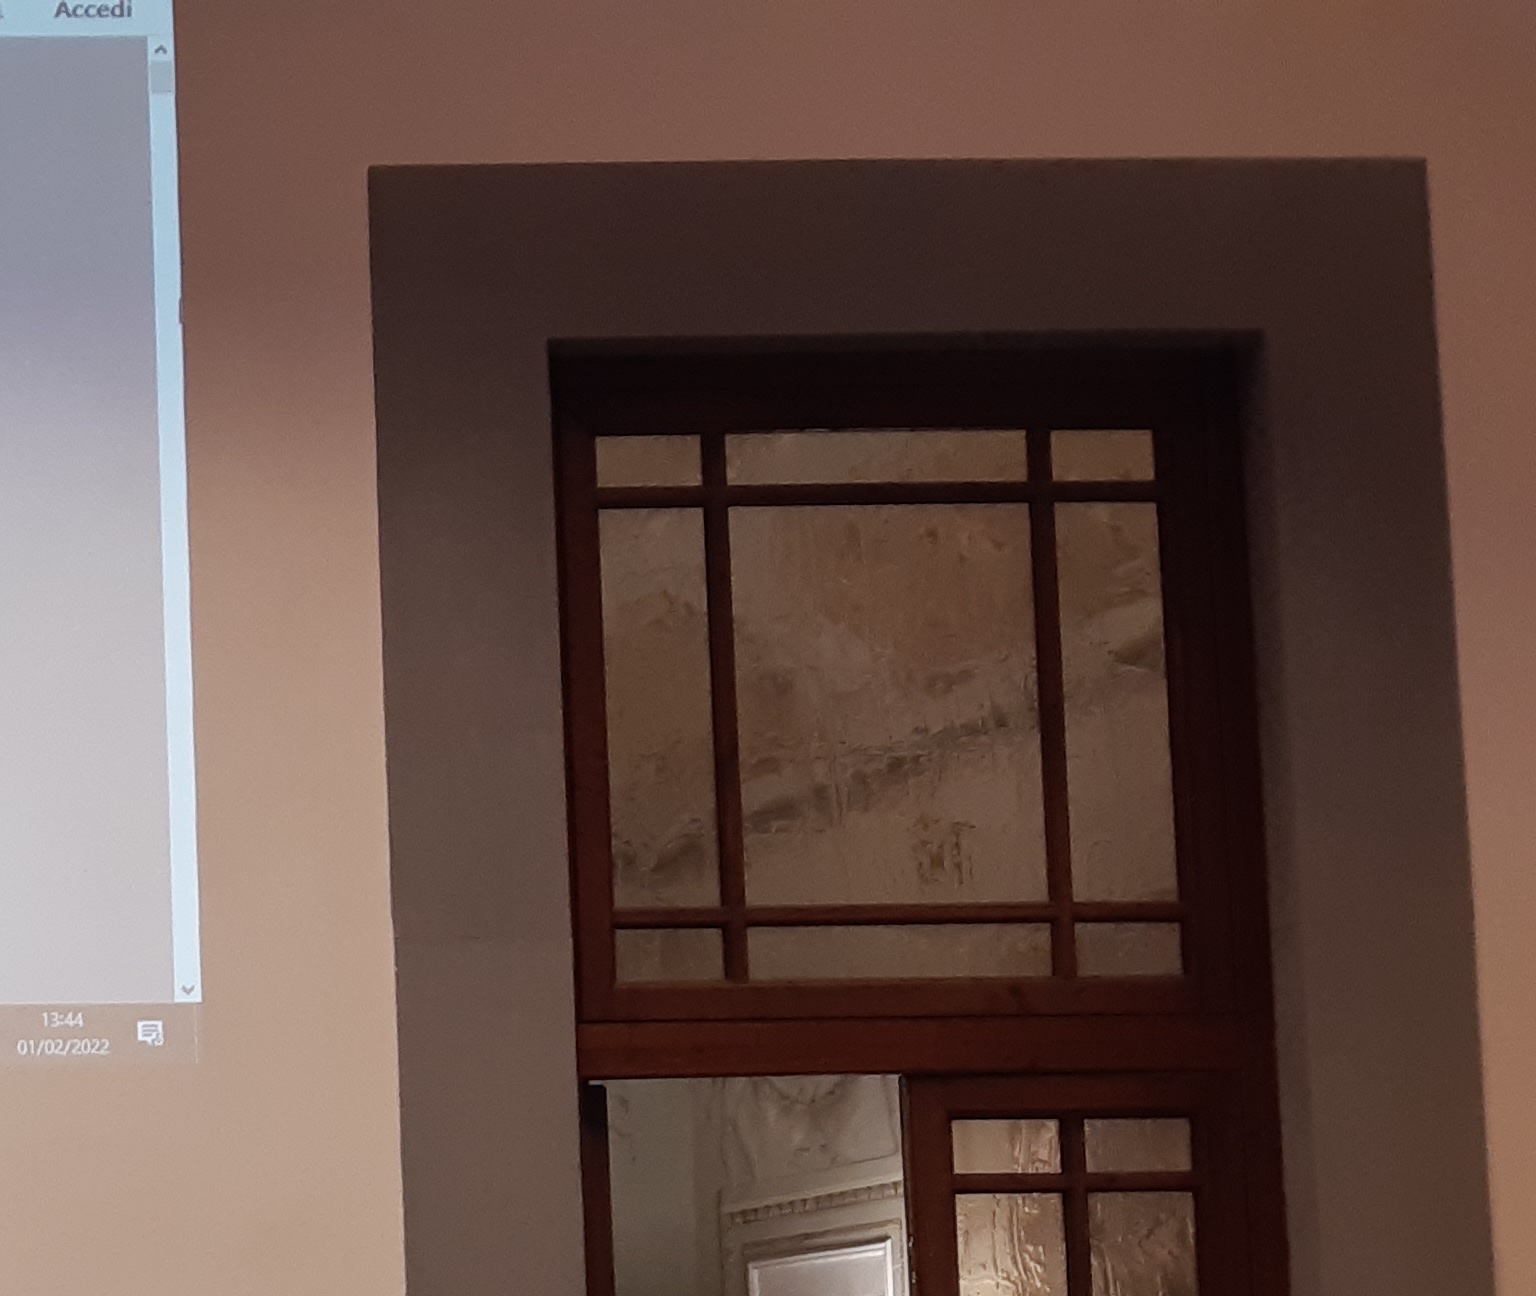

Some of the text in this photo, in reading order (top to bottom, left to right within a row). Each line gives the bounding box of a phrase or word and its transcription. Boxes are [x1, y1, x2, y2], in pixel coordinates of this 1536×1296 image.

[54, 0, 133, 19] Accedi
[41, 1011, 84, 1028] 13:44
[16, 1038, 110, 1056] 01/02/2022
